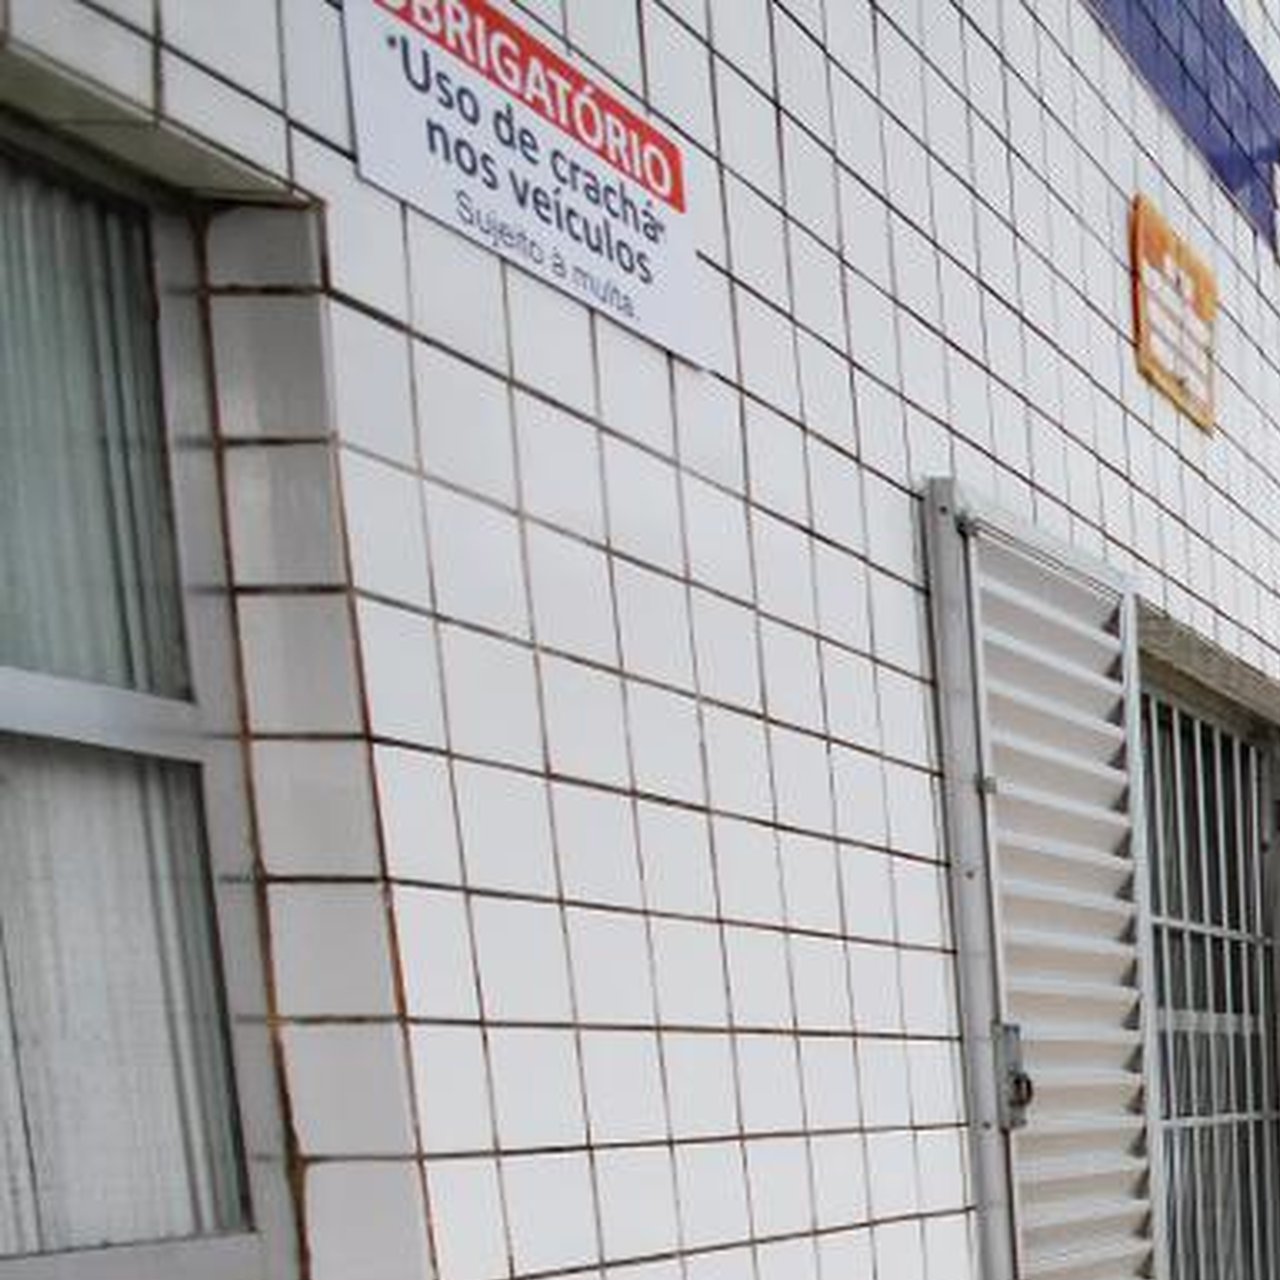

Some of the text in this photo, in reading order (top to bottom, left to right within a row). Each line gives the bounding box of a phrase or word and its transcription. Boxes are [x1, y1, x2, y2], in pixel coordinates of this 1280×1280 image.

[382, 0, 672, 198] BRIGATÓRIO
[493, 102, 540, 167] de
[426, 117, 654, 285] nos veículos
[456, 188, 544, 266] Sujeito
